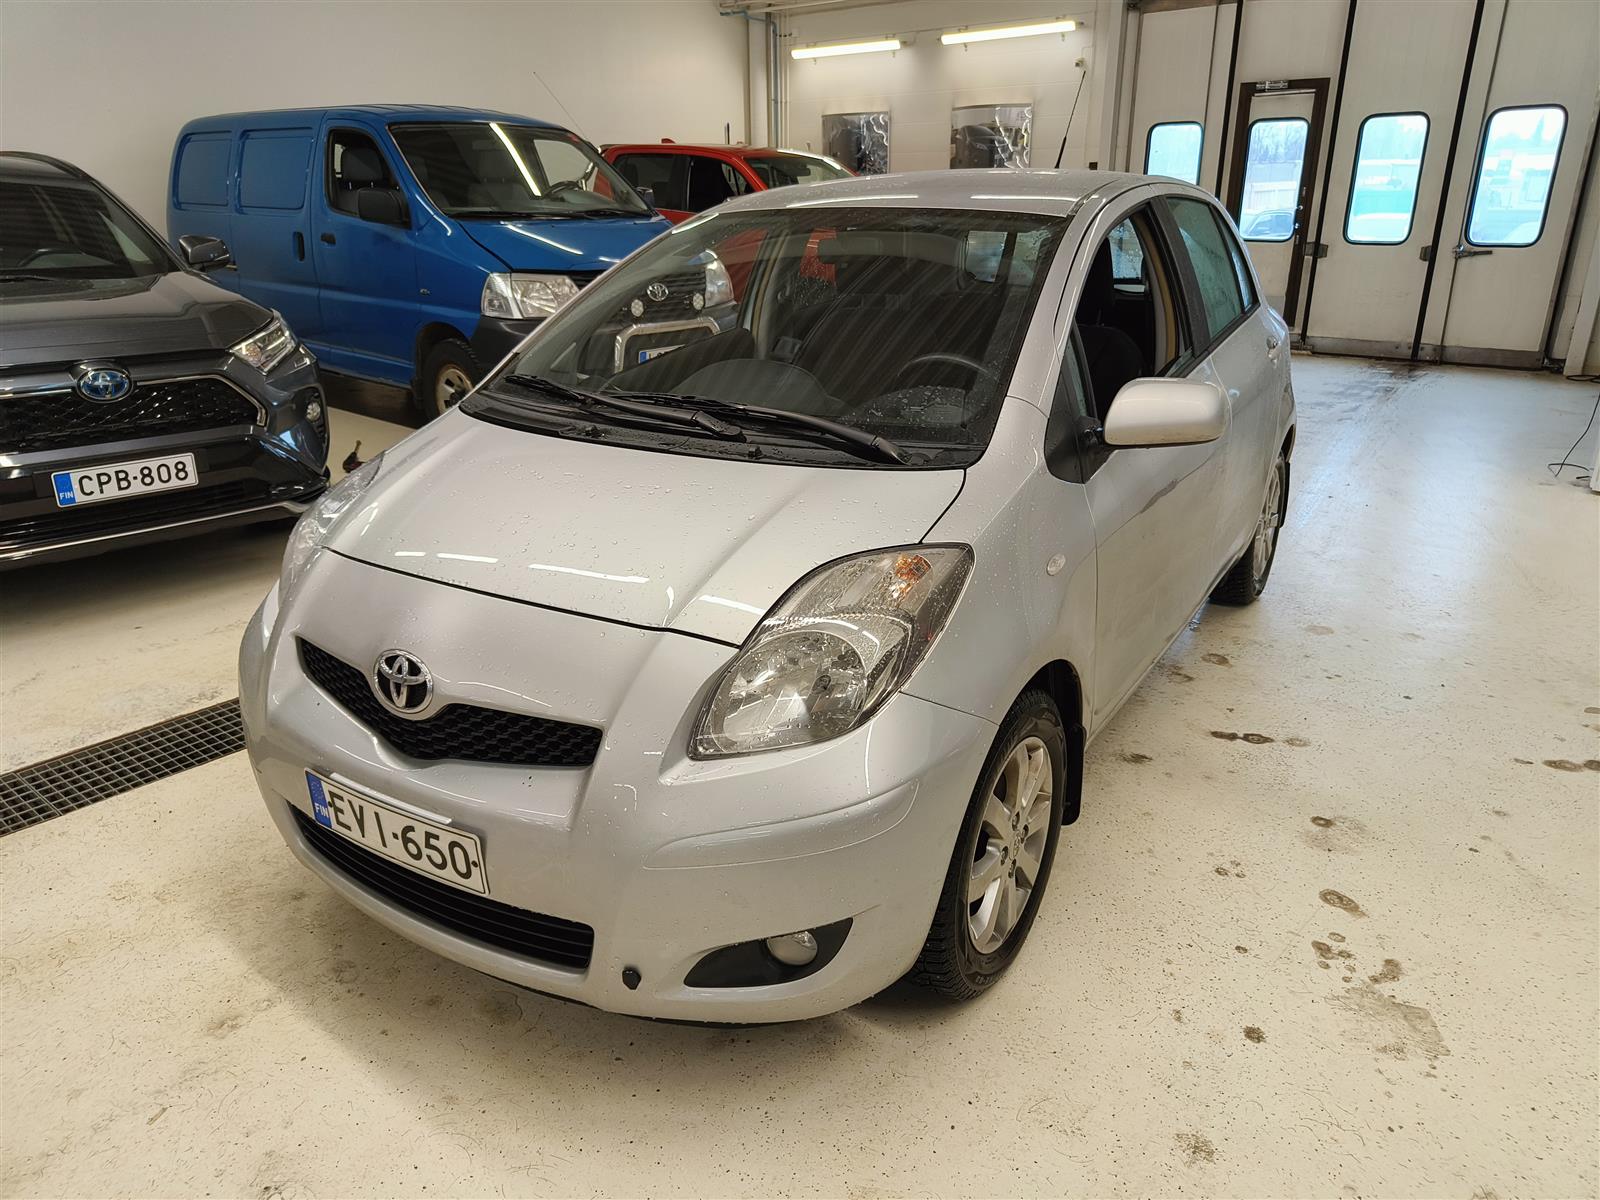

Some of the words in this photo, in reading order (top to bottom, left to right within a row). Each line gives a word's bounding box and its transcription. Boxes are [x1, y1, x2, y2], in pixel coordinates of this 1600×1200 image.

[78, 461, 189, 496] CPB-808
[59, 491, 74, 500] FIN
[314, 803, 330, 818] FIN
[328, 790, 472, 880] EVI-650
